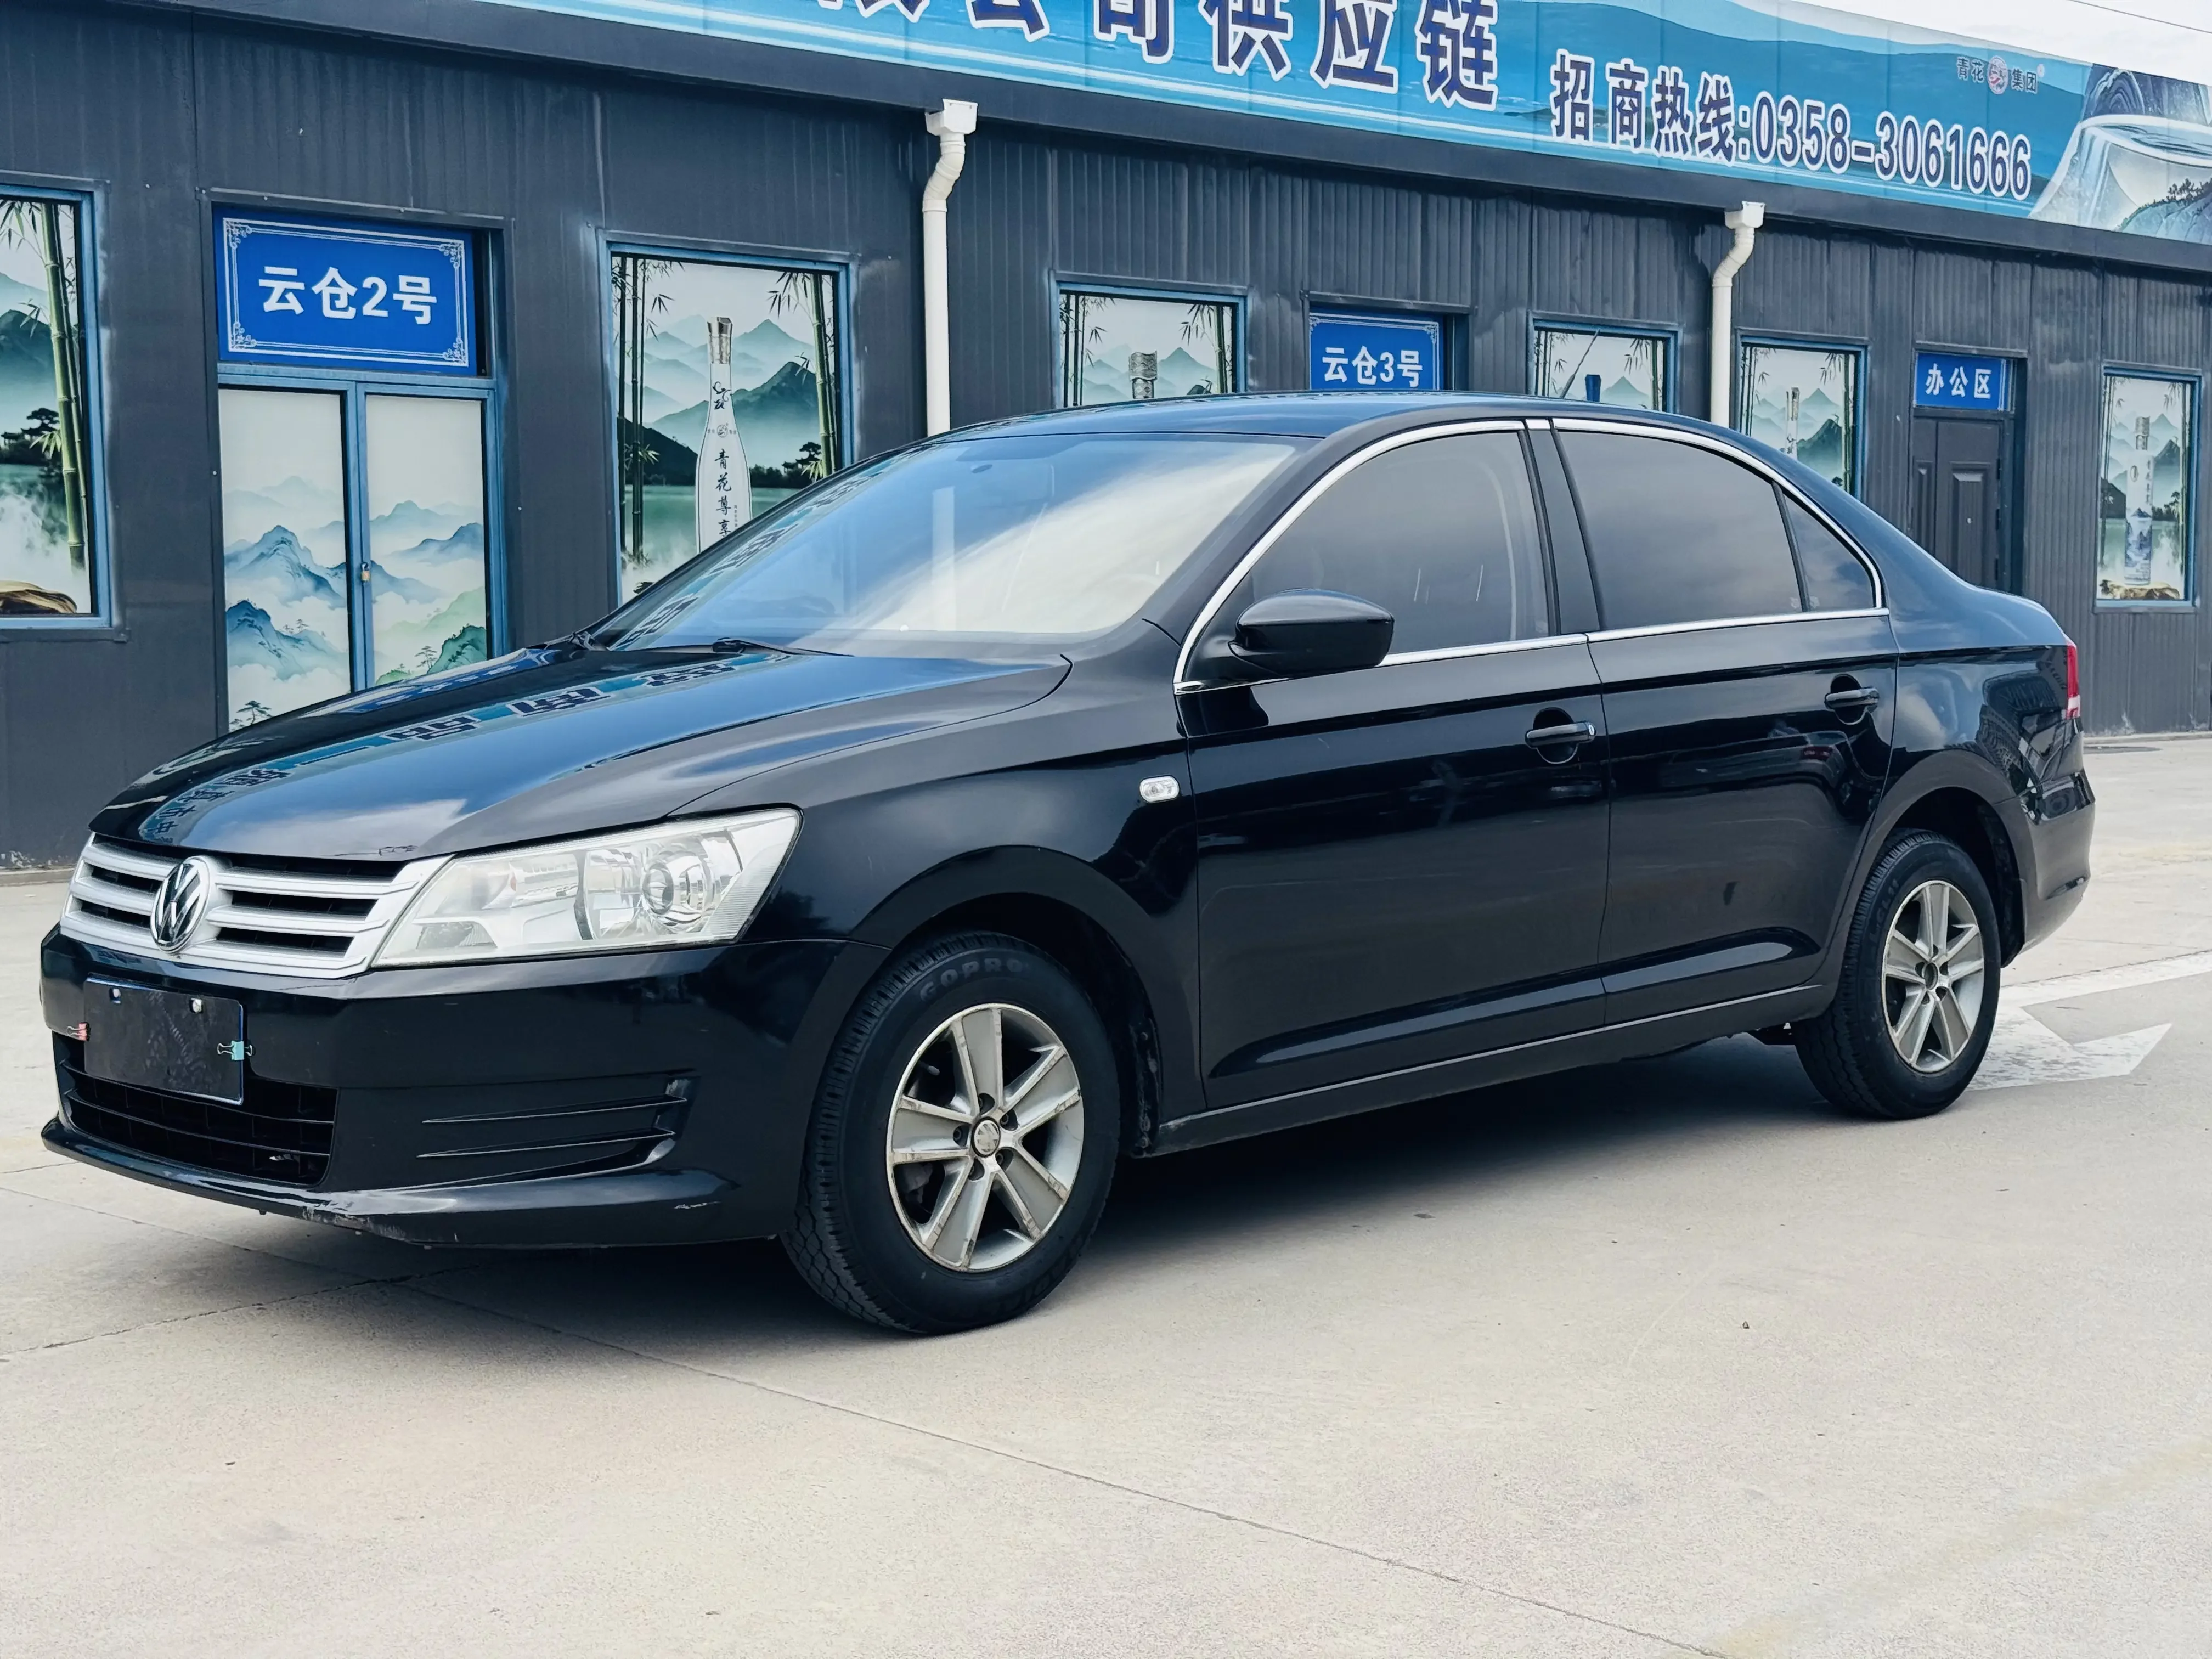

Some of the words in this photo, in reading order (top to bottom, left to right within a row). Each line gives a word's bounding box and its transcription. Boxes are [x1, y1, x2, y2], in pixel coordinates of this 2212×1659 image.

[1957, 57, 1984, 82] 青花
[2012, 67, 2037, 93] 集团
[258, 266, 437, 325] 云仓2号
[1322, 346, 1423, 387] 云仓3号
[1925, 363, 1991, 399] 办公区
